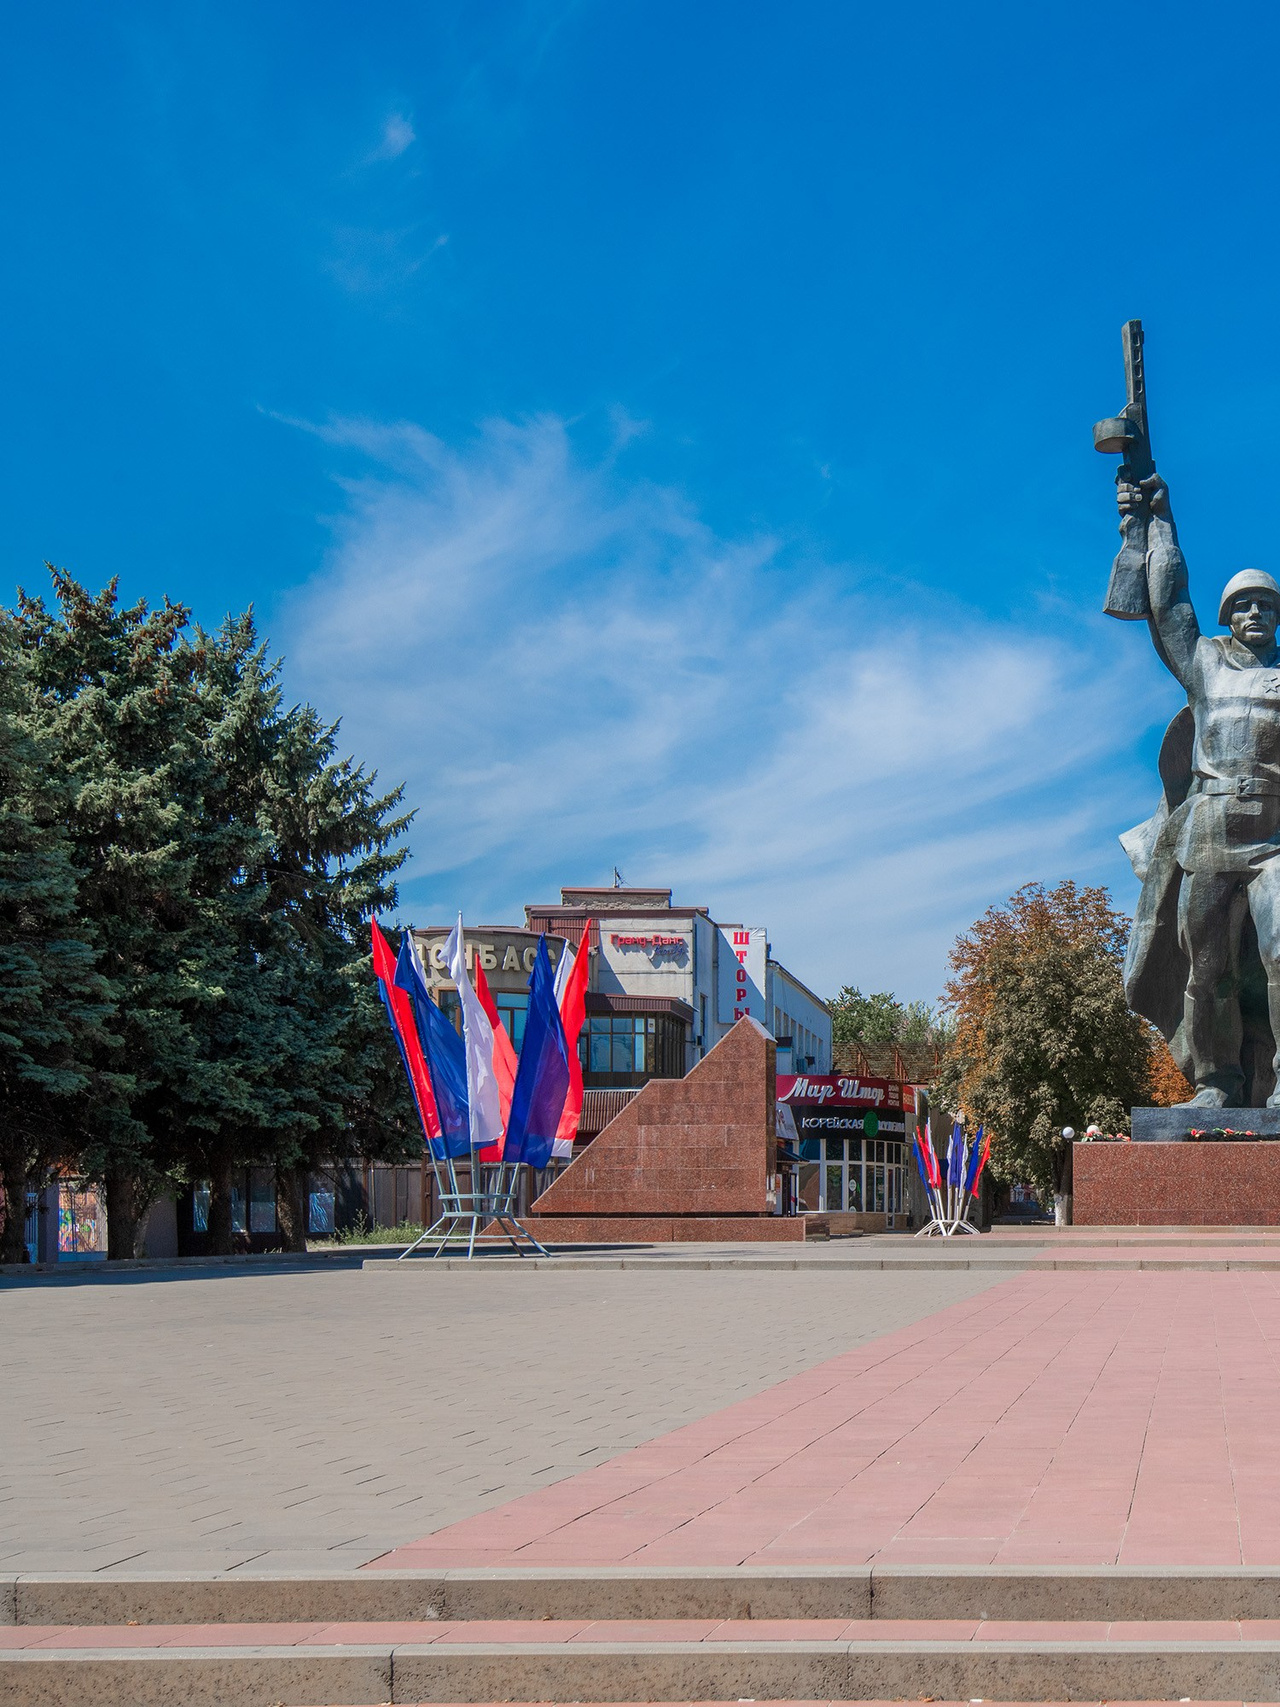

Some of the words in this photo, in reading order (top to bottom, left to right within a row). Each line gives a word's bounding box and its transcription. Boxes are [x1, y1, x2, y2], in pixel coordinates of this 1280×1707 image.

[733, 931, 750, 1021] ШТОРЫ
[778, 1077, 836, 1104] Мир
[838, 1078, 885, 1106] Штор
[801, 1116, 864, 1129] КОРЕЙСКАЯ
